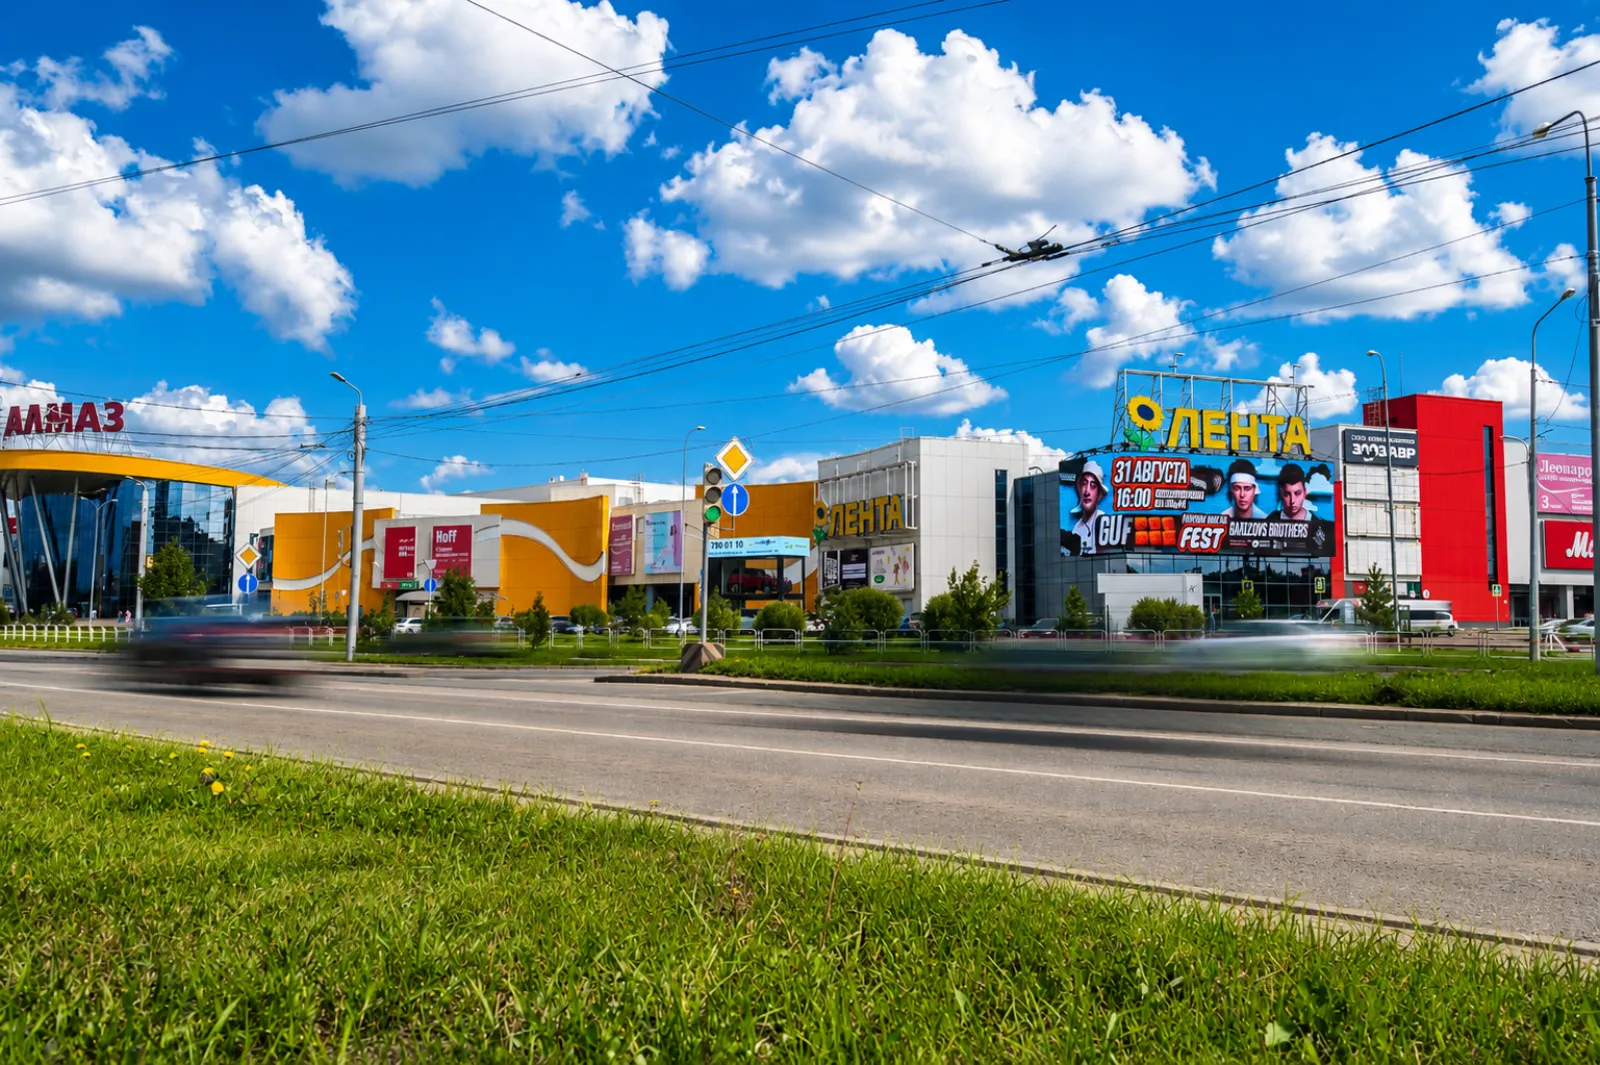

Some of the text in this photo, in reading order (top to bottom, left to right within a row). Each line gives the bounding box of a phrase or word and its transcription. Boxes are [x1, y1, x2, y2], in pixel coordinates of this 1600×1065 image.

[3, 400, 124, 440] АЛМАЗ
[1165, 407, 1312, 455] ЛЕНТА
[1114, 460, 1187, 484] 31 АВГУСТА
[1116, 487, 1152, 508] 16:00
[828, 494, 904, 537] ЛЕНТА
[436, 529, 457, 544] Hoff
[1098, 513, 1133, 546] GUF
[1180, 526, 1225, 549] FEST
[1268, 522, 1309, 539] BROTHERS
